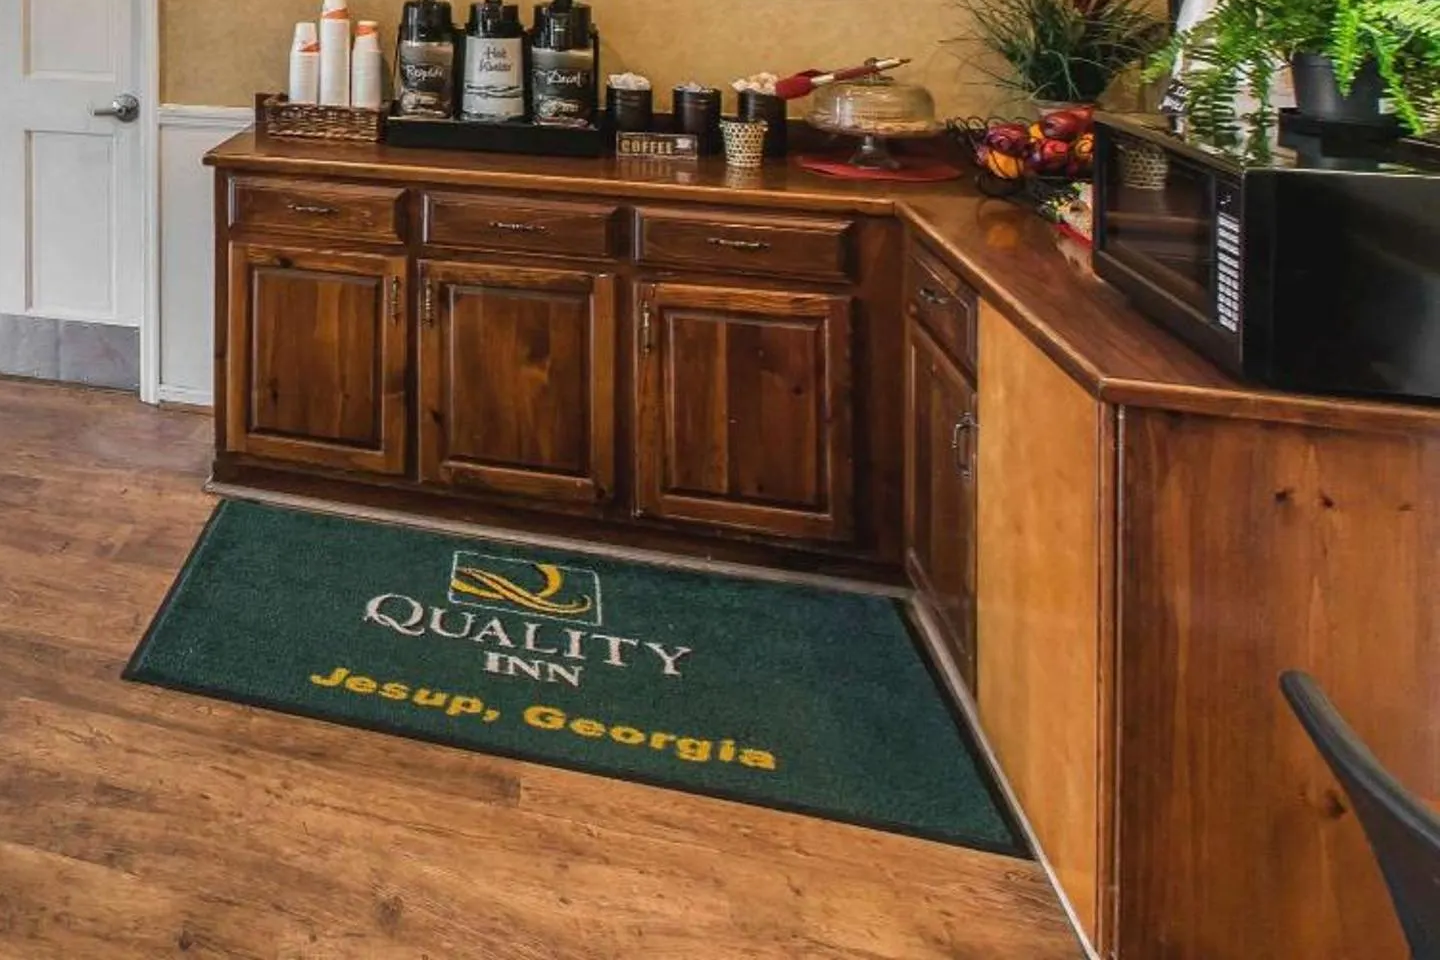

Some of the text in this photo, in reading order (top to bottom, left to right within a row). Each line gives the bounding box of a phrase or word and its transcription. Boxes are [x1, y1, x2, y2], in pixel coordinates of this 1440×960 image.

[485, 46, 507, 58] Hot
[621, 138, 673, 154] COFFEE
[363, 593, 692, 676] QUALITY
[484, 650, 583, 688] INN
[310, 666, 777, 771] Jesup, Georgia
